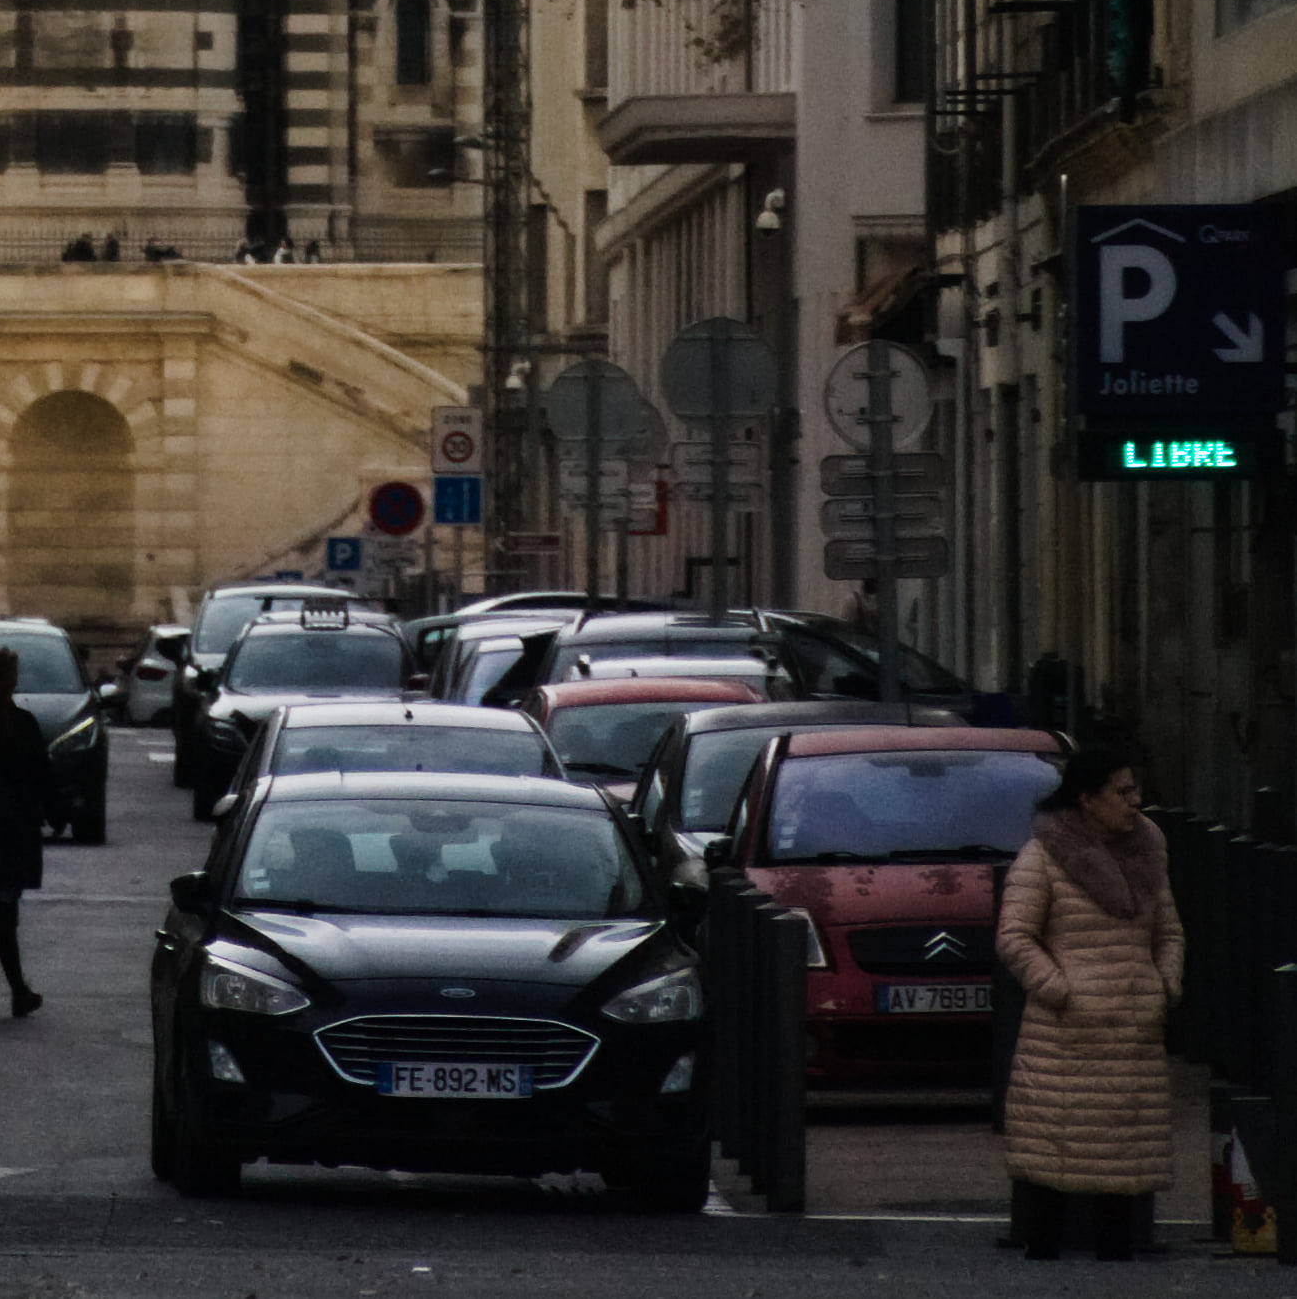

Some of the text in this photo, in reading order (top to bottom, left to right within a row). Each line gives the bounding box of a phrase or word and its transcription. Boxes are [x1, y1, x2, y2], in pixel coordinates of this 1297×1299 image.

[1100, 244, 1177, 363] P
[1099, 370, 1199, 395] Joliette
[1123, 440, 1237, 469] LIBRE
[334, 543, 353, 566] P
[890, 987, 988, 1010] AV-769-D
[394, 1067, 516, 1093] FE-892-MS
